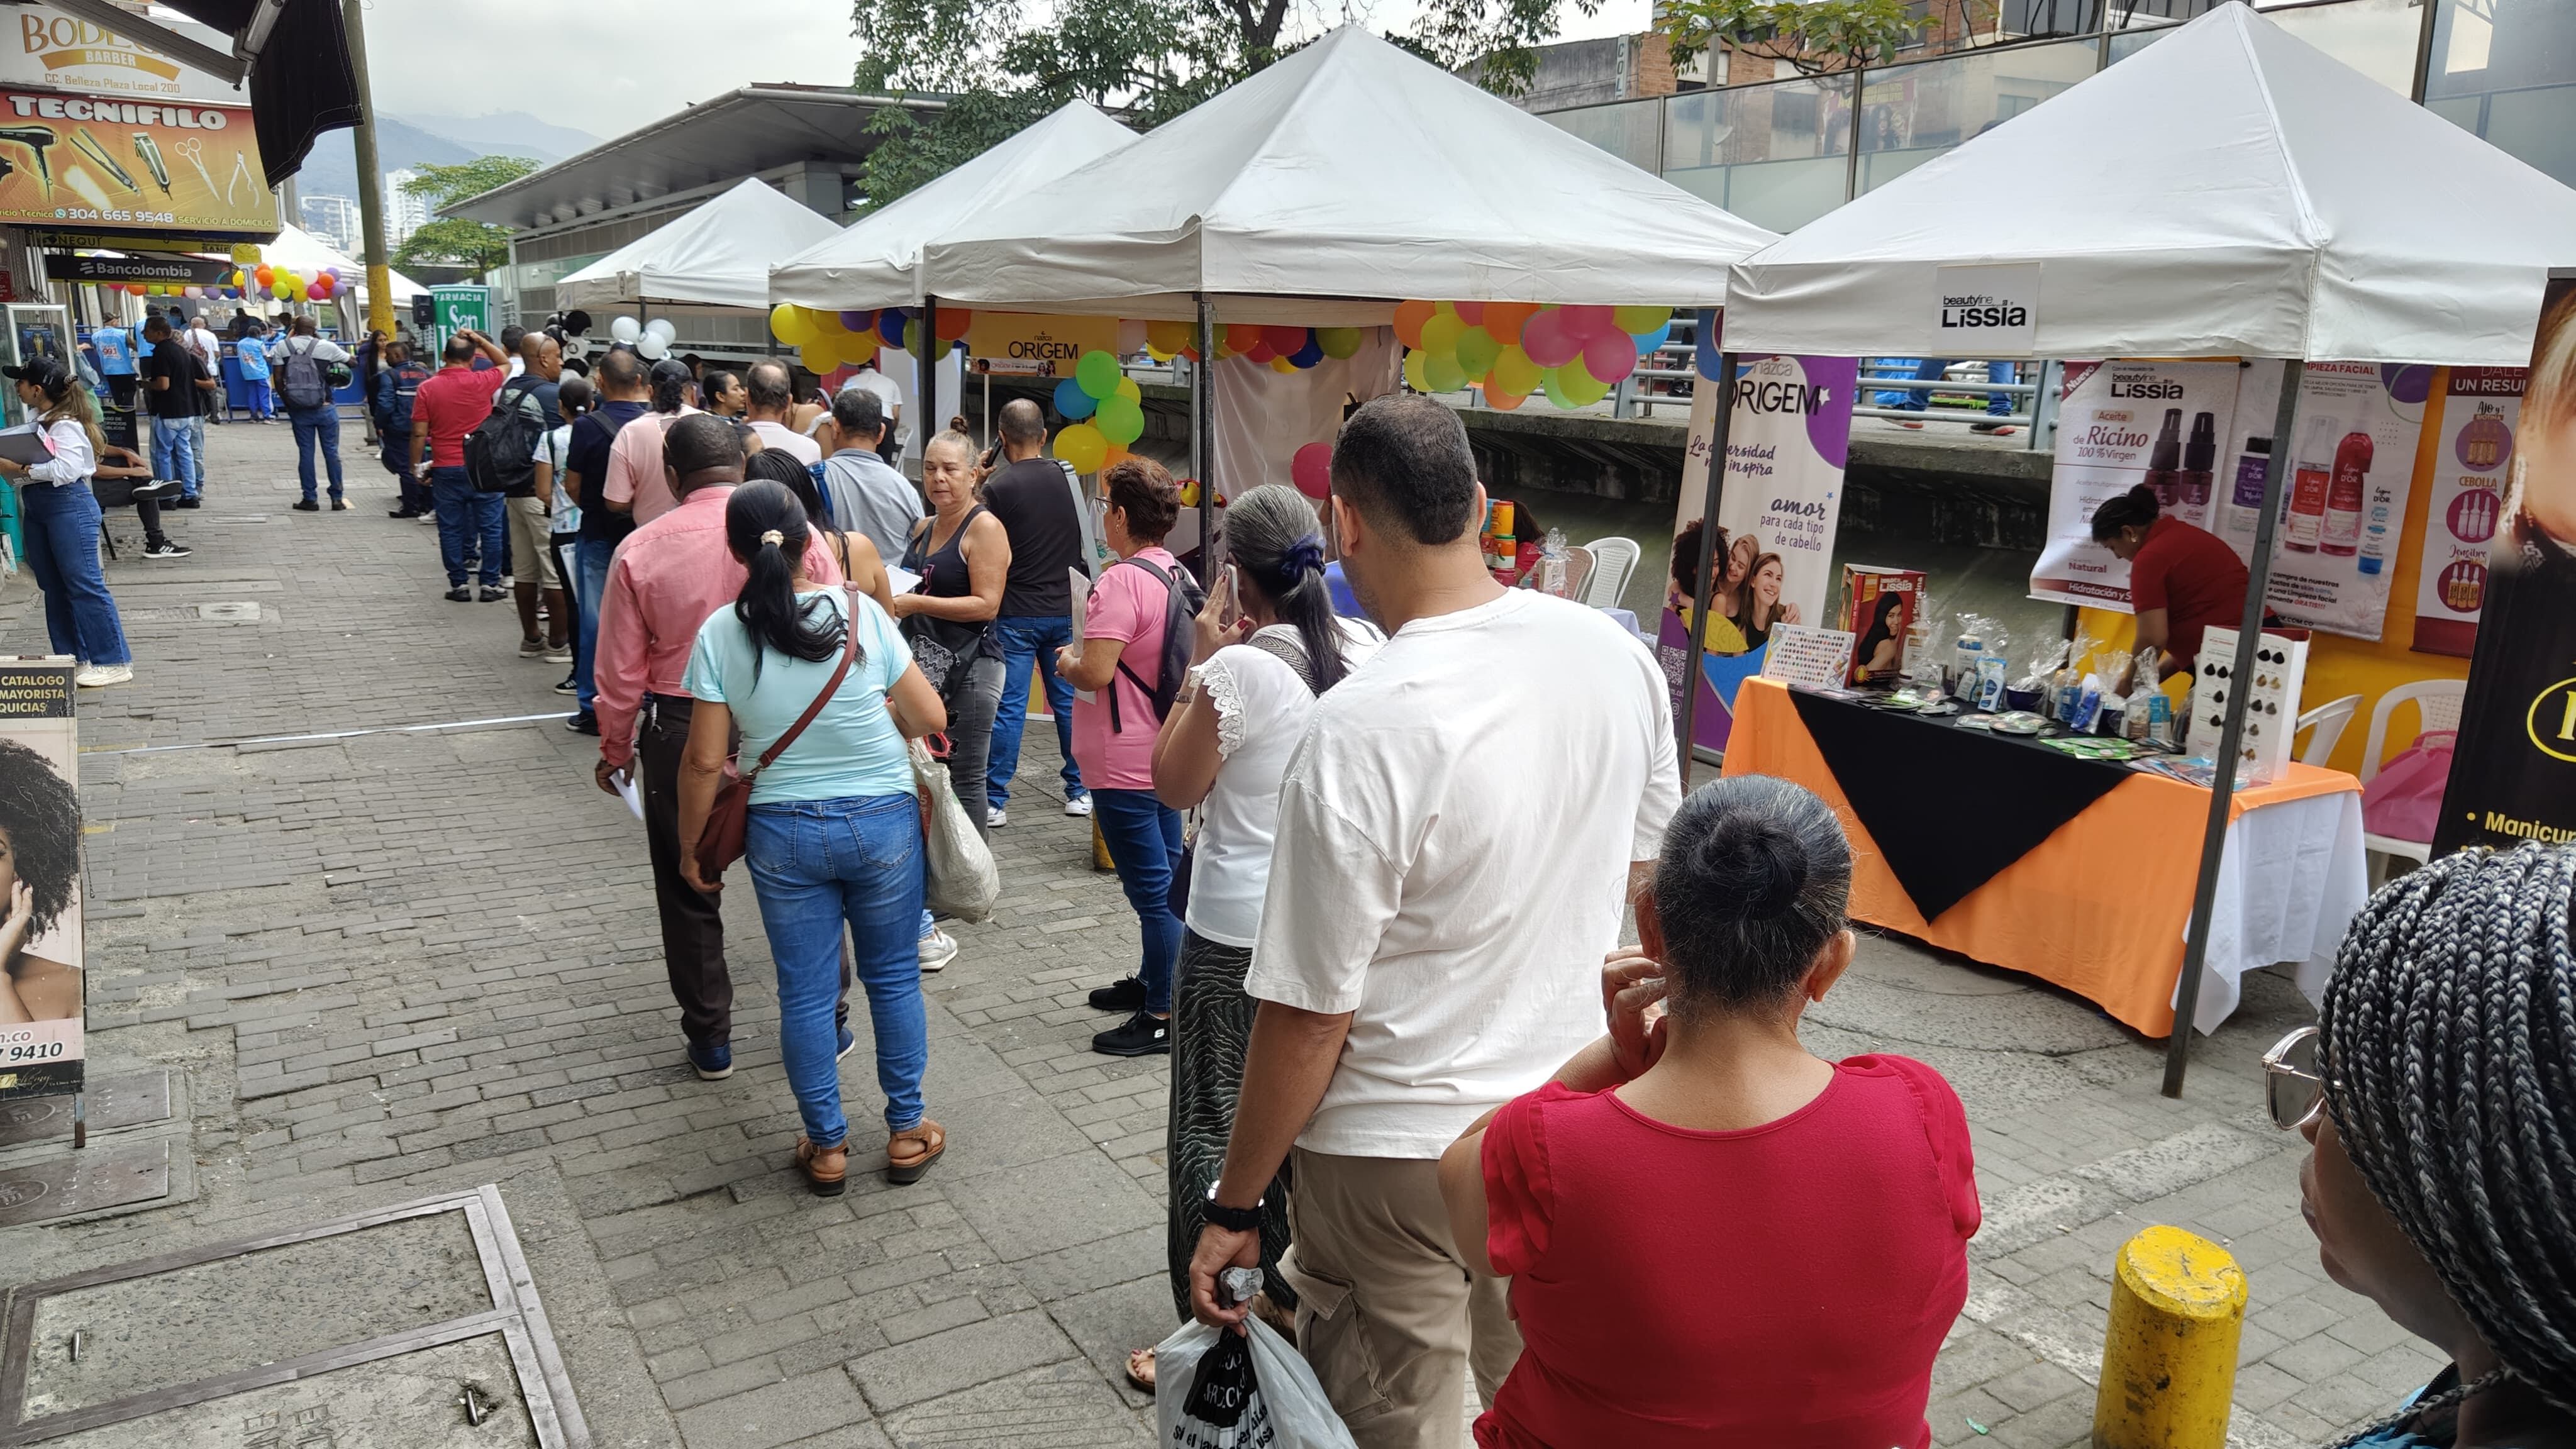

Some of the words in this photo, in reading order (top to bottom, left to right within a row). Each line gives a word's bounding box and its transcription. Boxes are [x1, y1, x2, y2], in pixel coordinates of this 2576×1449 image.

[85, 50, 136, 67] BARBER
[45, 73, 62, 84] CC.
[65, 75, 101, 88] Belleza
[103, 78, 130, 90] Plaza
[132, 80, 158, 92] Local
[8, 96, 227, 130] TECNIFILO
[20, 209, 54, 218] Tecnico
[68, 208, 98, 220] 304
[102, 209, 131, 221] 665
[135, 211, 174, 223] 9548
[176, 216, 219, 225] SERVICIO
[221, 218, 228, 226] A
[230, 218, 272, 228] DOMICILIO
[96, 262, 192, 277] Bancolombia
[433, 292, 482, 303] FARMACIA
[448, 304, 479, 336] San
[1941, 307, 2027, 328] Lissia
[1008, 340, 1079, 360] ORIGEM
[1753, 361, 1793, 377] nazca
[2339, 364, 2375, 375] FACIAL
[2480, 366, 2523, 377] DALE
[2065, 365, 2096, 392] Nuevo
[2455, 378, 2477, 392] UN
[2110, 383, 2184, 400] Lissia
[2098, 411, 2127, 422] Aceite
[2073, 435, 2084, 445] de
[2087, 425, 2149, 448] Ricino
[1689, 435, 1706, 457] La
[2077, 447, 2094, 458] 100
[2106, 449, 2137, 462] Virgen
[1728, 458, 1774, 479] inspira
[2340, 475, 2358, 484] D'OR
[2458, 475, 2497, 487] CEBOLLA
[1770, 497, 1826, 521] amor
[1760, 514, 1781, 528] para
[1782, 516, 1803, 531] cada
[1806, 519, 1824, 535] tipo
[1774, 530, 1787, 545] de
[1789, 533, 1822, 552] cabello
[2068, 562, 2107, 574] Natural
[2272, 571, 2298, 582] compra
[2307, 577, 2340, 589] nuestros
[2300, 584, 2314, 593] skin
[2068, 582, 2118, 599] Hidratación
[2118, 591, 2124, 601] y
[2287, 588, 2318, 601] Limpieza
[2318, 594, 2337, 604] facial
[1, 675, 65, 686] CATALOGO
[0, 689, 66, 701] MAYORISTA
[0, 701, 47, 713] QUICIAS
[9, 1041, 64, 1062] 9410
[1186, 1433, 1197, 1448] el
